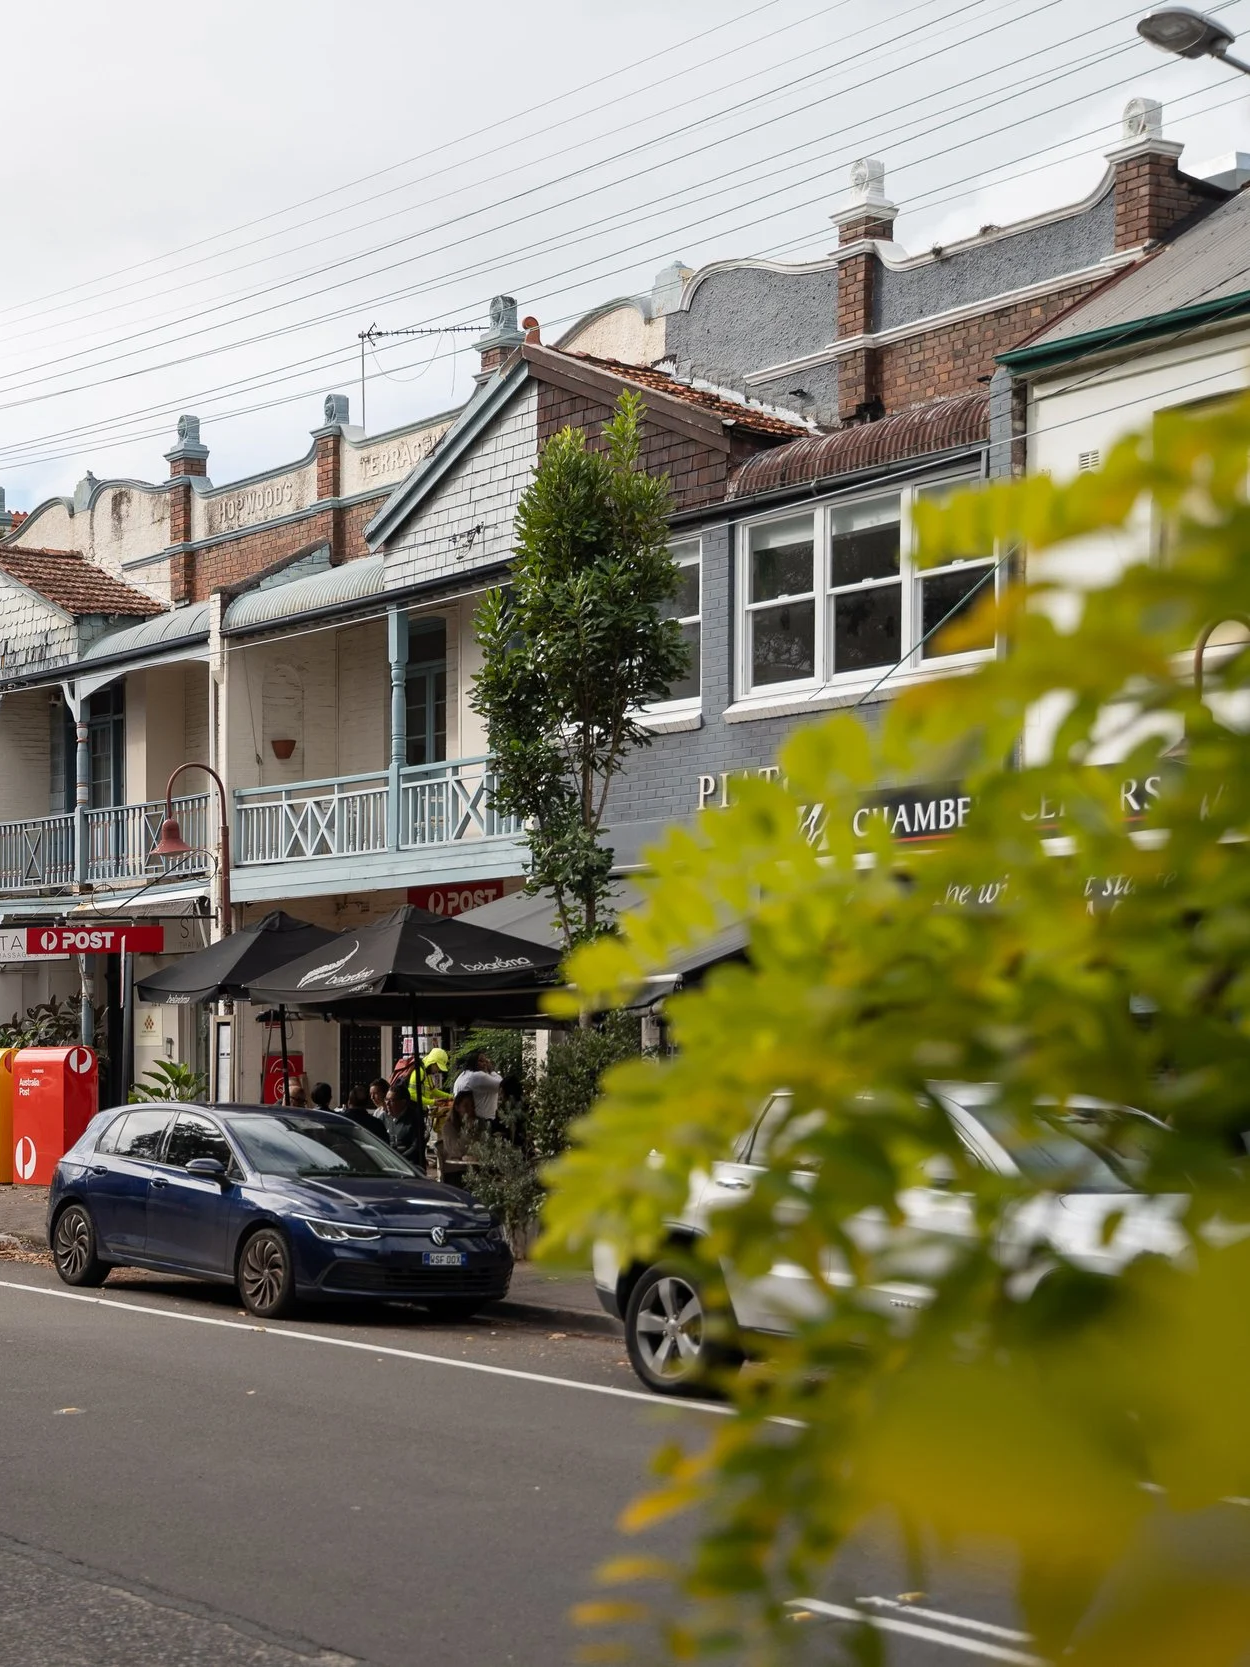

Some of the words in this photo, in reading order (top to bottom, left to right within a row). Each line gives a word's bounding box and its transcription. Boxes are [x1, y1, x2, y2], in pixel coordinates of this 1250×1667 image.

[447, 889, 497, 914] POST
[62, 931, 114, 949] POST
[19, 1078, 40, 1087] Australia
[19, 1088, 30, 1096] Post
